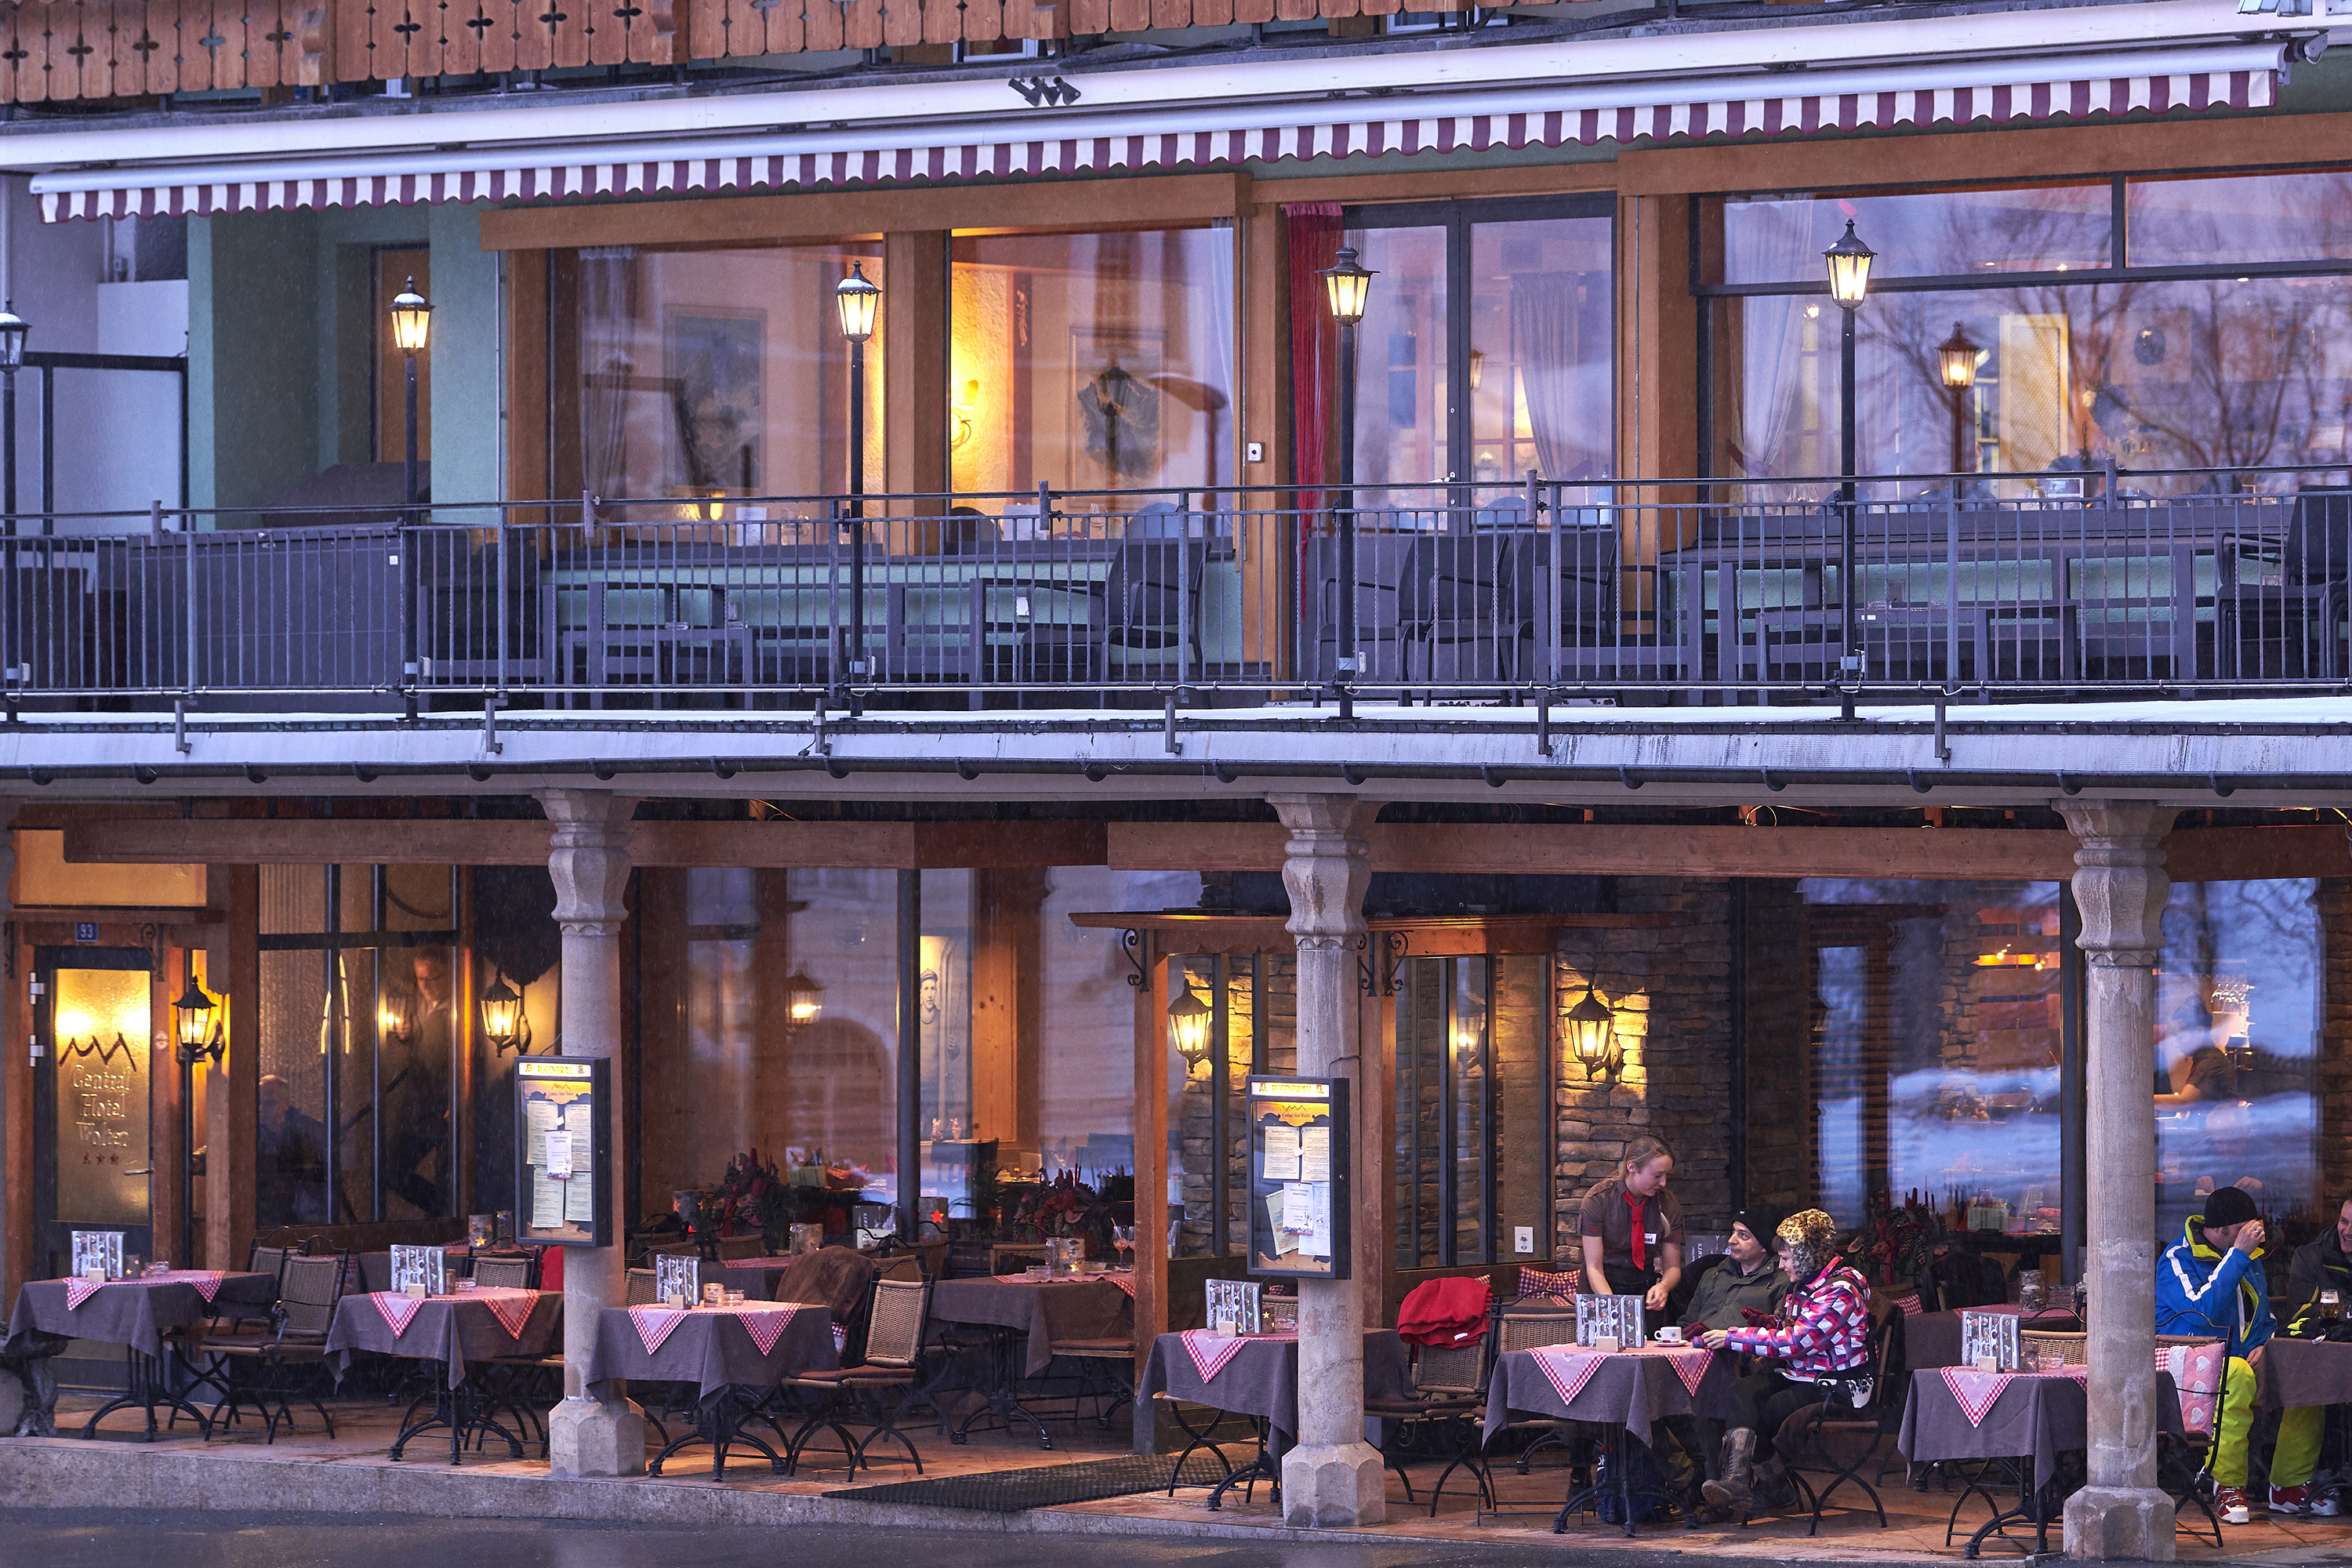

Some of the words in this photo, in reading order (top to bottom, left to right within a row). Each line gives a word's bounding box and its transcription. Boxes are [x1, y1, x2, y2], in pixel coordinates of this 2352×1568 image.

[80, 924, 93, 938] 93
[73, 1064, 129, 1090] Central
[80, 1093, 125, 1117] Hotel
